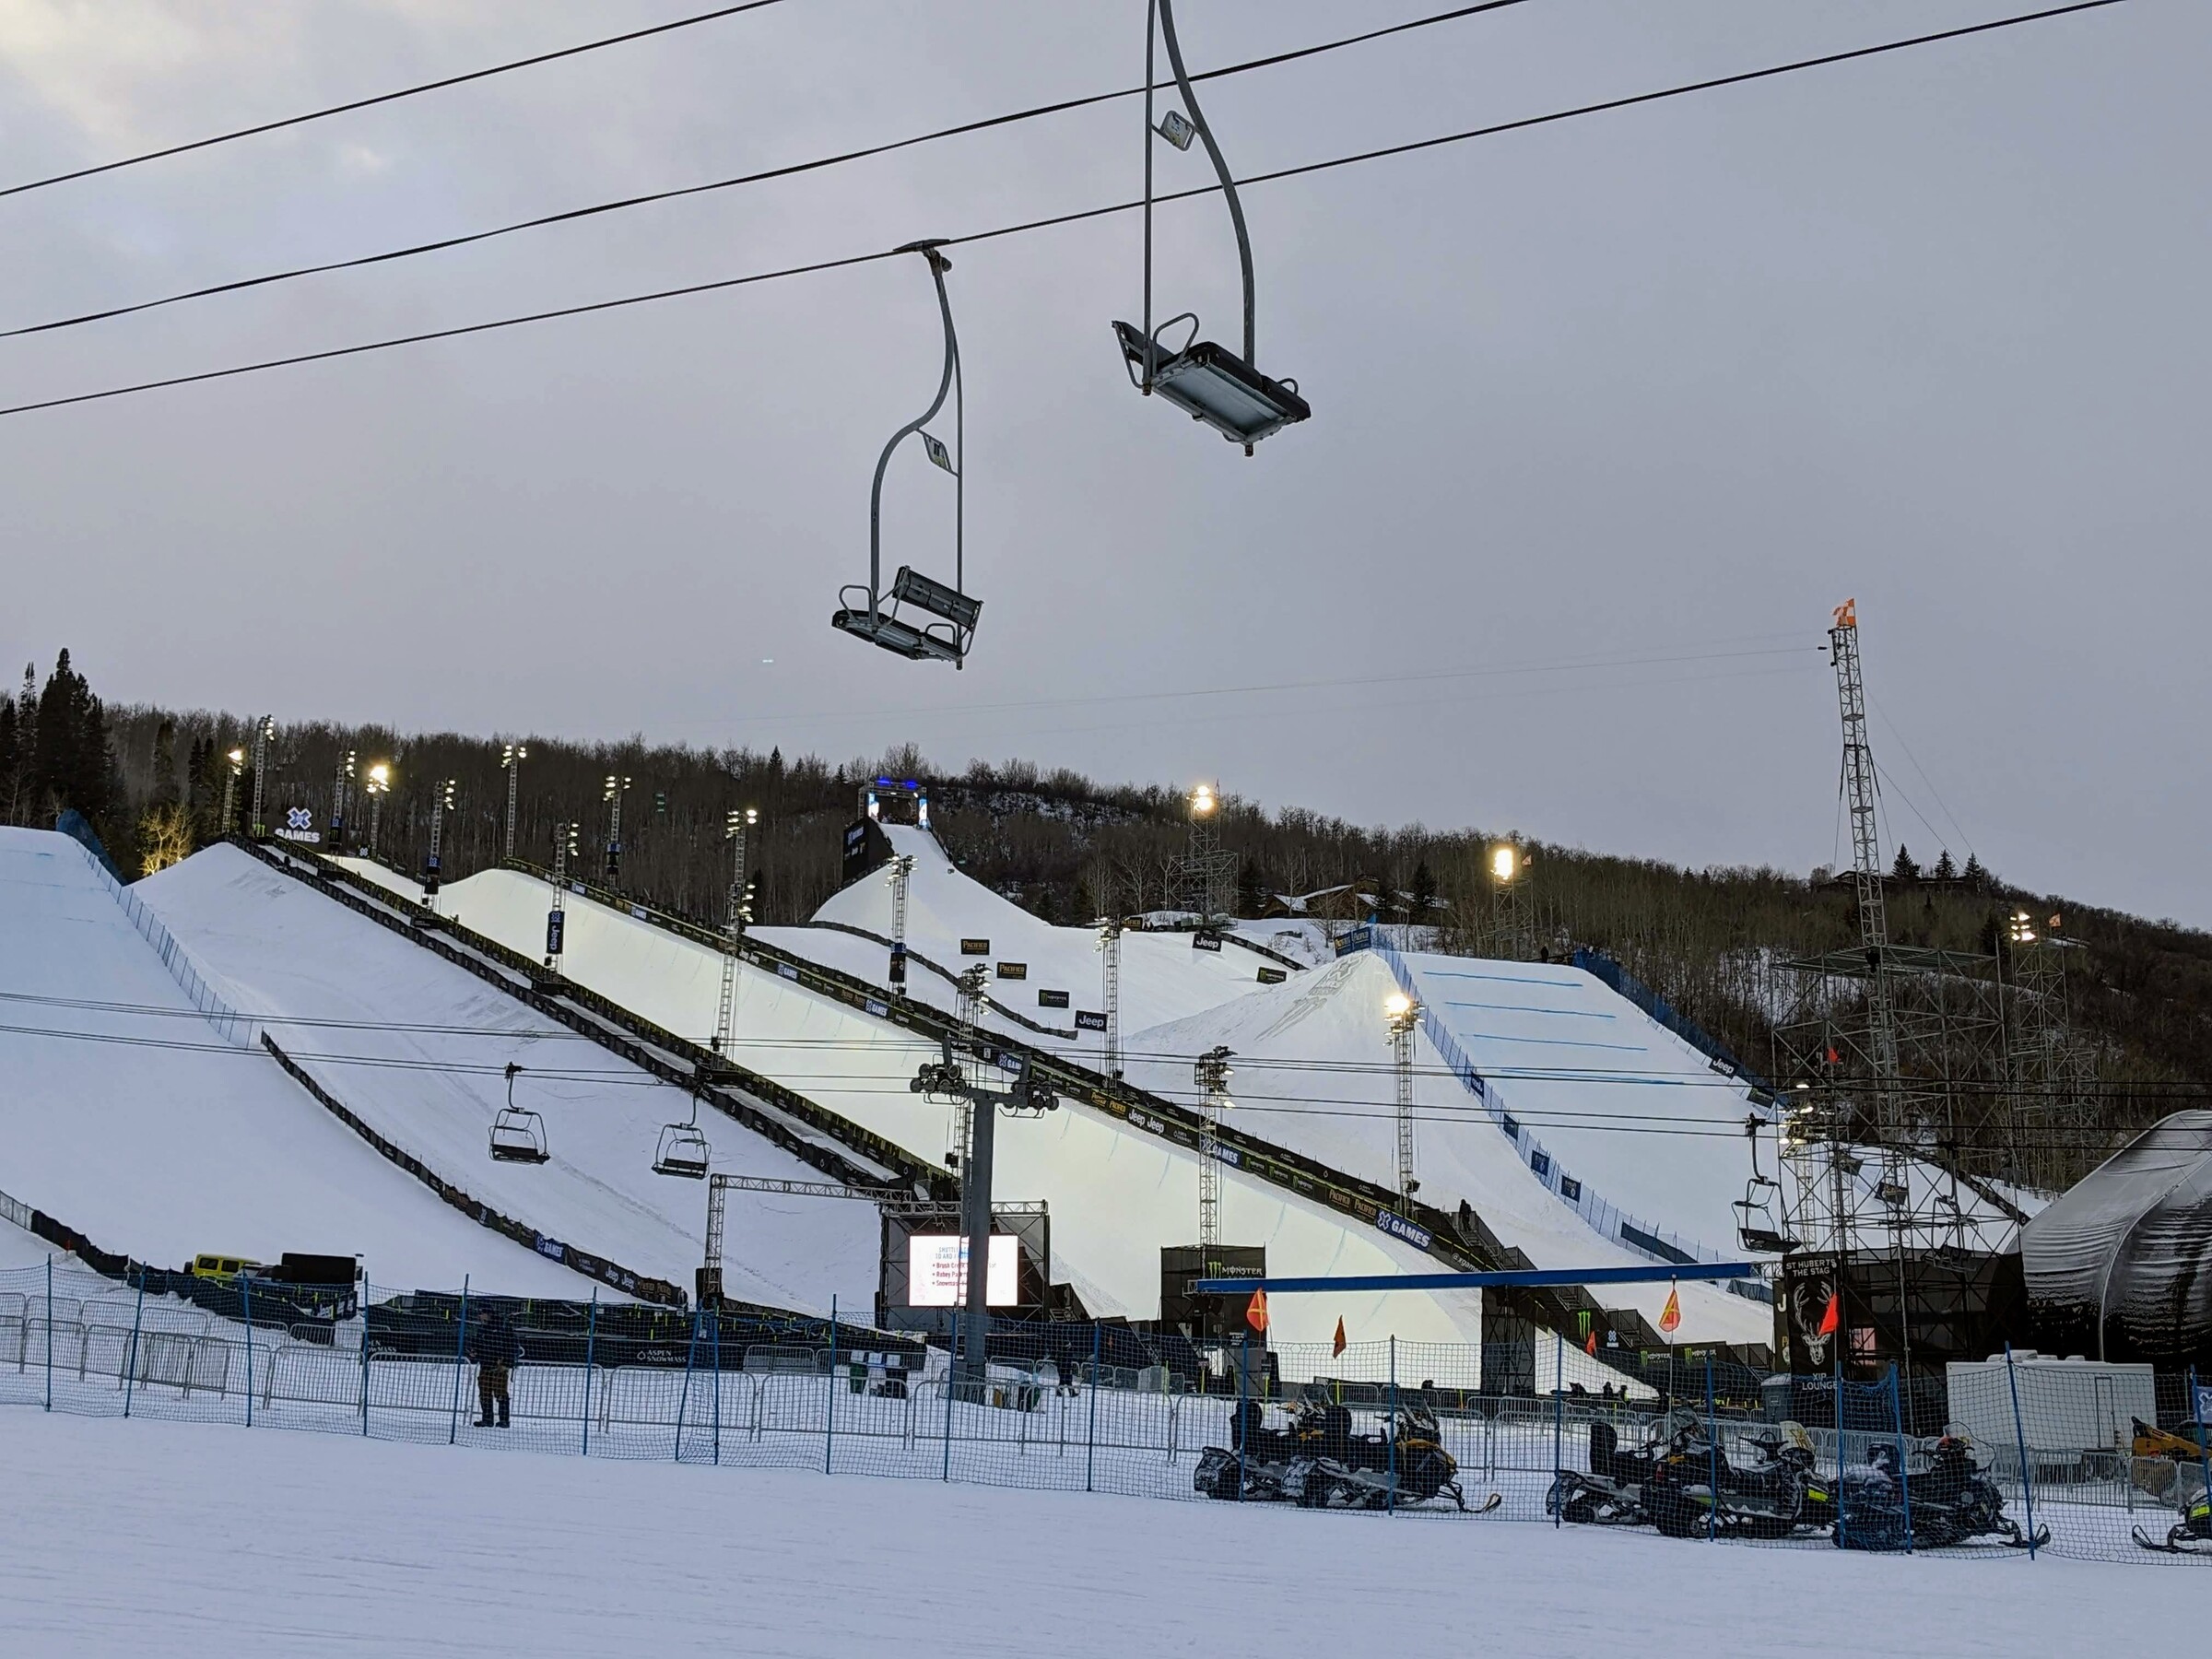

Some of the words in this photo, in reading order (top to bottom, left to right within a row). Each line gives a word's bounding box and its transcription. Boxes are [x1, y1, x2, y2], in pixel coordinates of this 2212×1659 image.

[275, 828, 320, 843] GAMES
[550, 924, 560, 951] Jeep
[963, 940, 988, 948] PACIFICO
[1196, 936, 1219, 949] Jeep
[999, 964, 1025, 973] PACIFICO
[1078, 1015, 1104, 1028] Jeep
[1712, 1058, 1735, 1074] Jeep
[1129, 1109, 1146, 1127] Jeep
[1147, 1117, 1164, 1135] Jeep
[1329, 1189, 1350, 1206] PACIFICO
[1354, 1198, 1377, 1217] PACIFICO
[1391, 1219, 1430, 1248] GAMES
[1222, 1265, 1263, 1276] MONSTER
[1786, 1262, 1796, 1270] ST
[1798, 1259, 1837, 1269] HUBERTS
[606, 1265, 619, 1284] Jeep
[621, 1272, 635, 1290] Jeep
[1793, 1269, 1808, 1277] THE
[1811, 1266, 1830, 1276] STAG
[1802, 1382, 1838, 1391] LOUNGE
